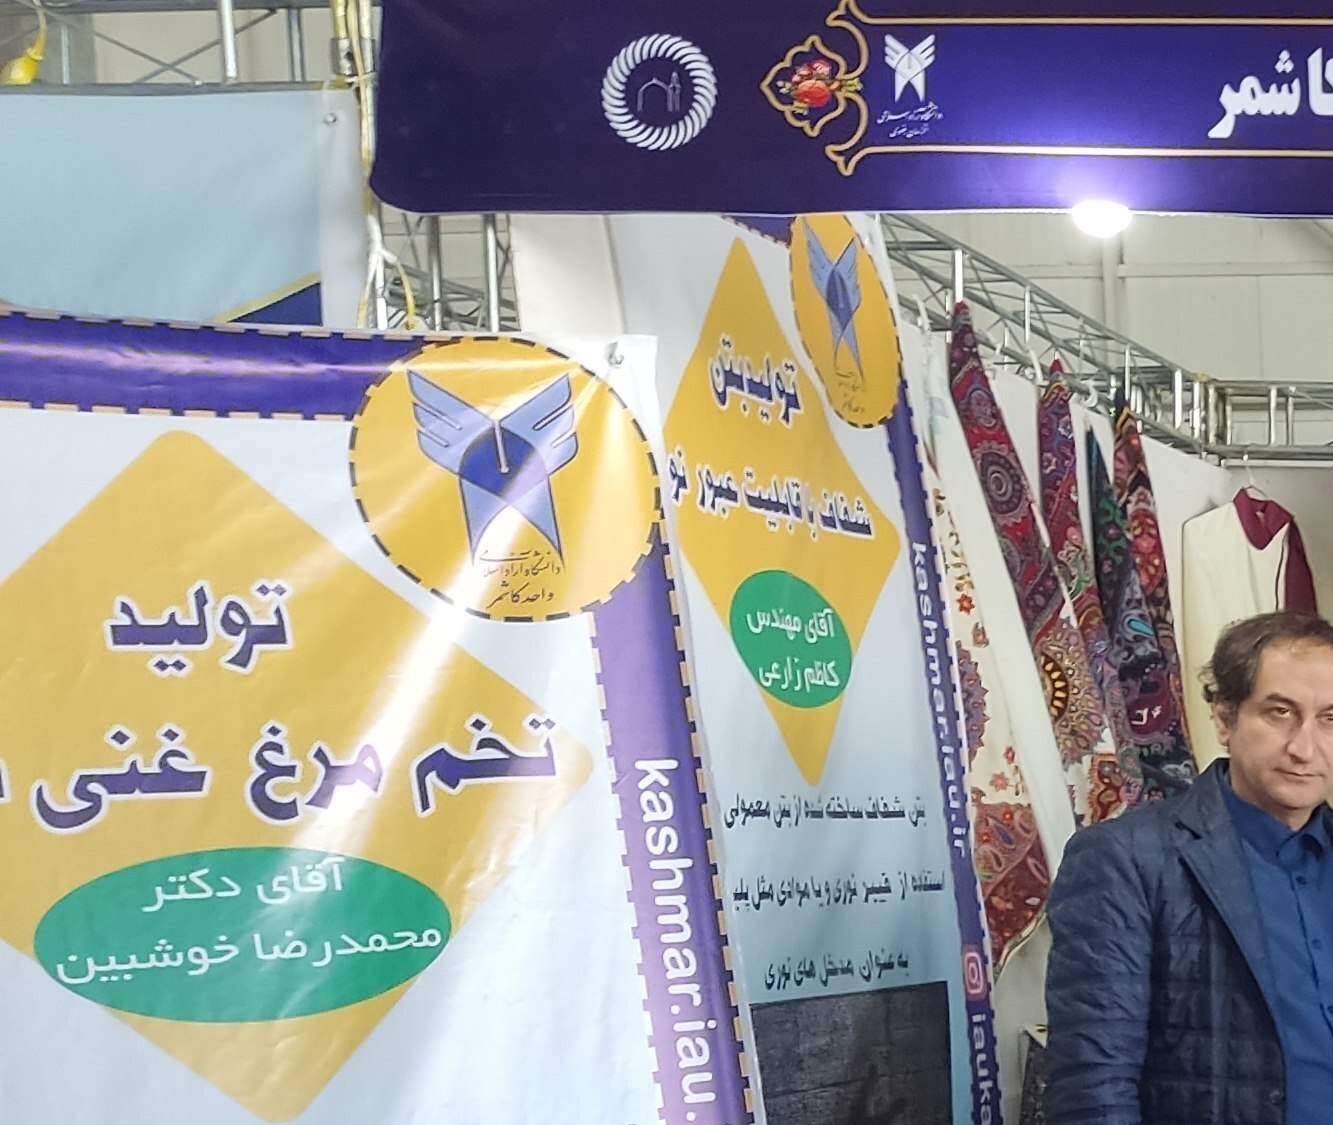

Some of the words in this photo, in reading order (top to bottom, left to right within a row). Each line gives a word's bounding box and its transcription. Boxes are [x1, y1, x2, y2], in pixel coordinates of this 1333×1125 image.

[698, 466, 740, 518] عبور
[742, 466, 803, 528] قابلیت
[820, 498, 873, 535] شفاف
[108, 582, 292, 674] تولید
[746, 608, 802, 642] مهندس
[804, 609, 834, 644] آقای
[803, 659, 840, 688] کاظم
[911, 543, 966, 857] kashmar.iau.ir
[36, 724, 209, 830] غنی
[246, 721, 384, 819] مرغ
[415, 714, 557, 816] تخم
[724, 793, 770, 829] معمولی
[826, 795, 863, 819] ساخته
[865, 796, 905, 819] شفاف
[142, 872, 241, 911] دکتر
[256, 856, 345, 905] آقای
[752, 876, 773, 910] مثل
[863, 873, 892, 903] فیبر
[55, 932, 240, 986] خوشبین
[253, 925, 443, 968] محمدرضا
[765, 958, 790, 990] نوری
[793, 955, 816, 985] های
[859, 948, 895, 983] عنوان
